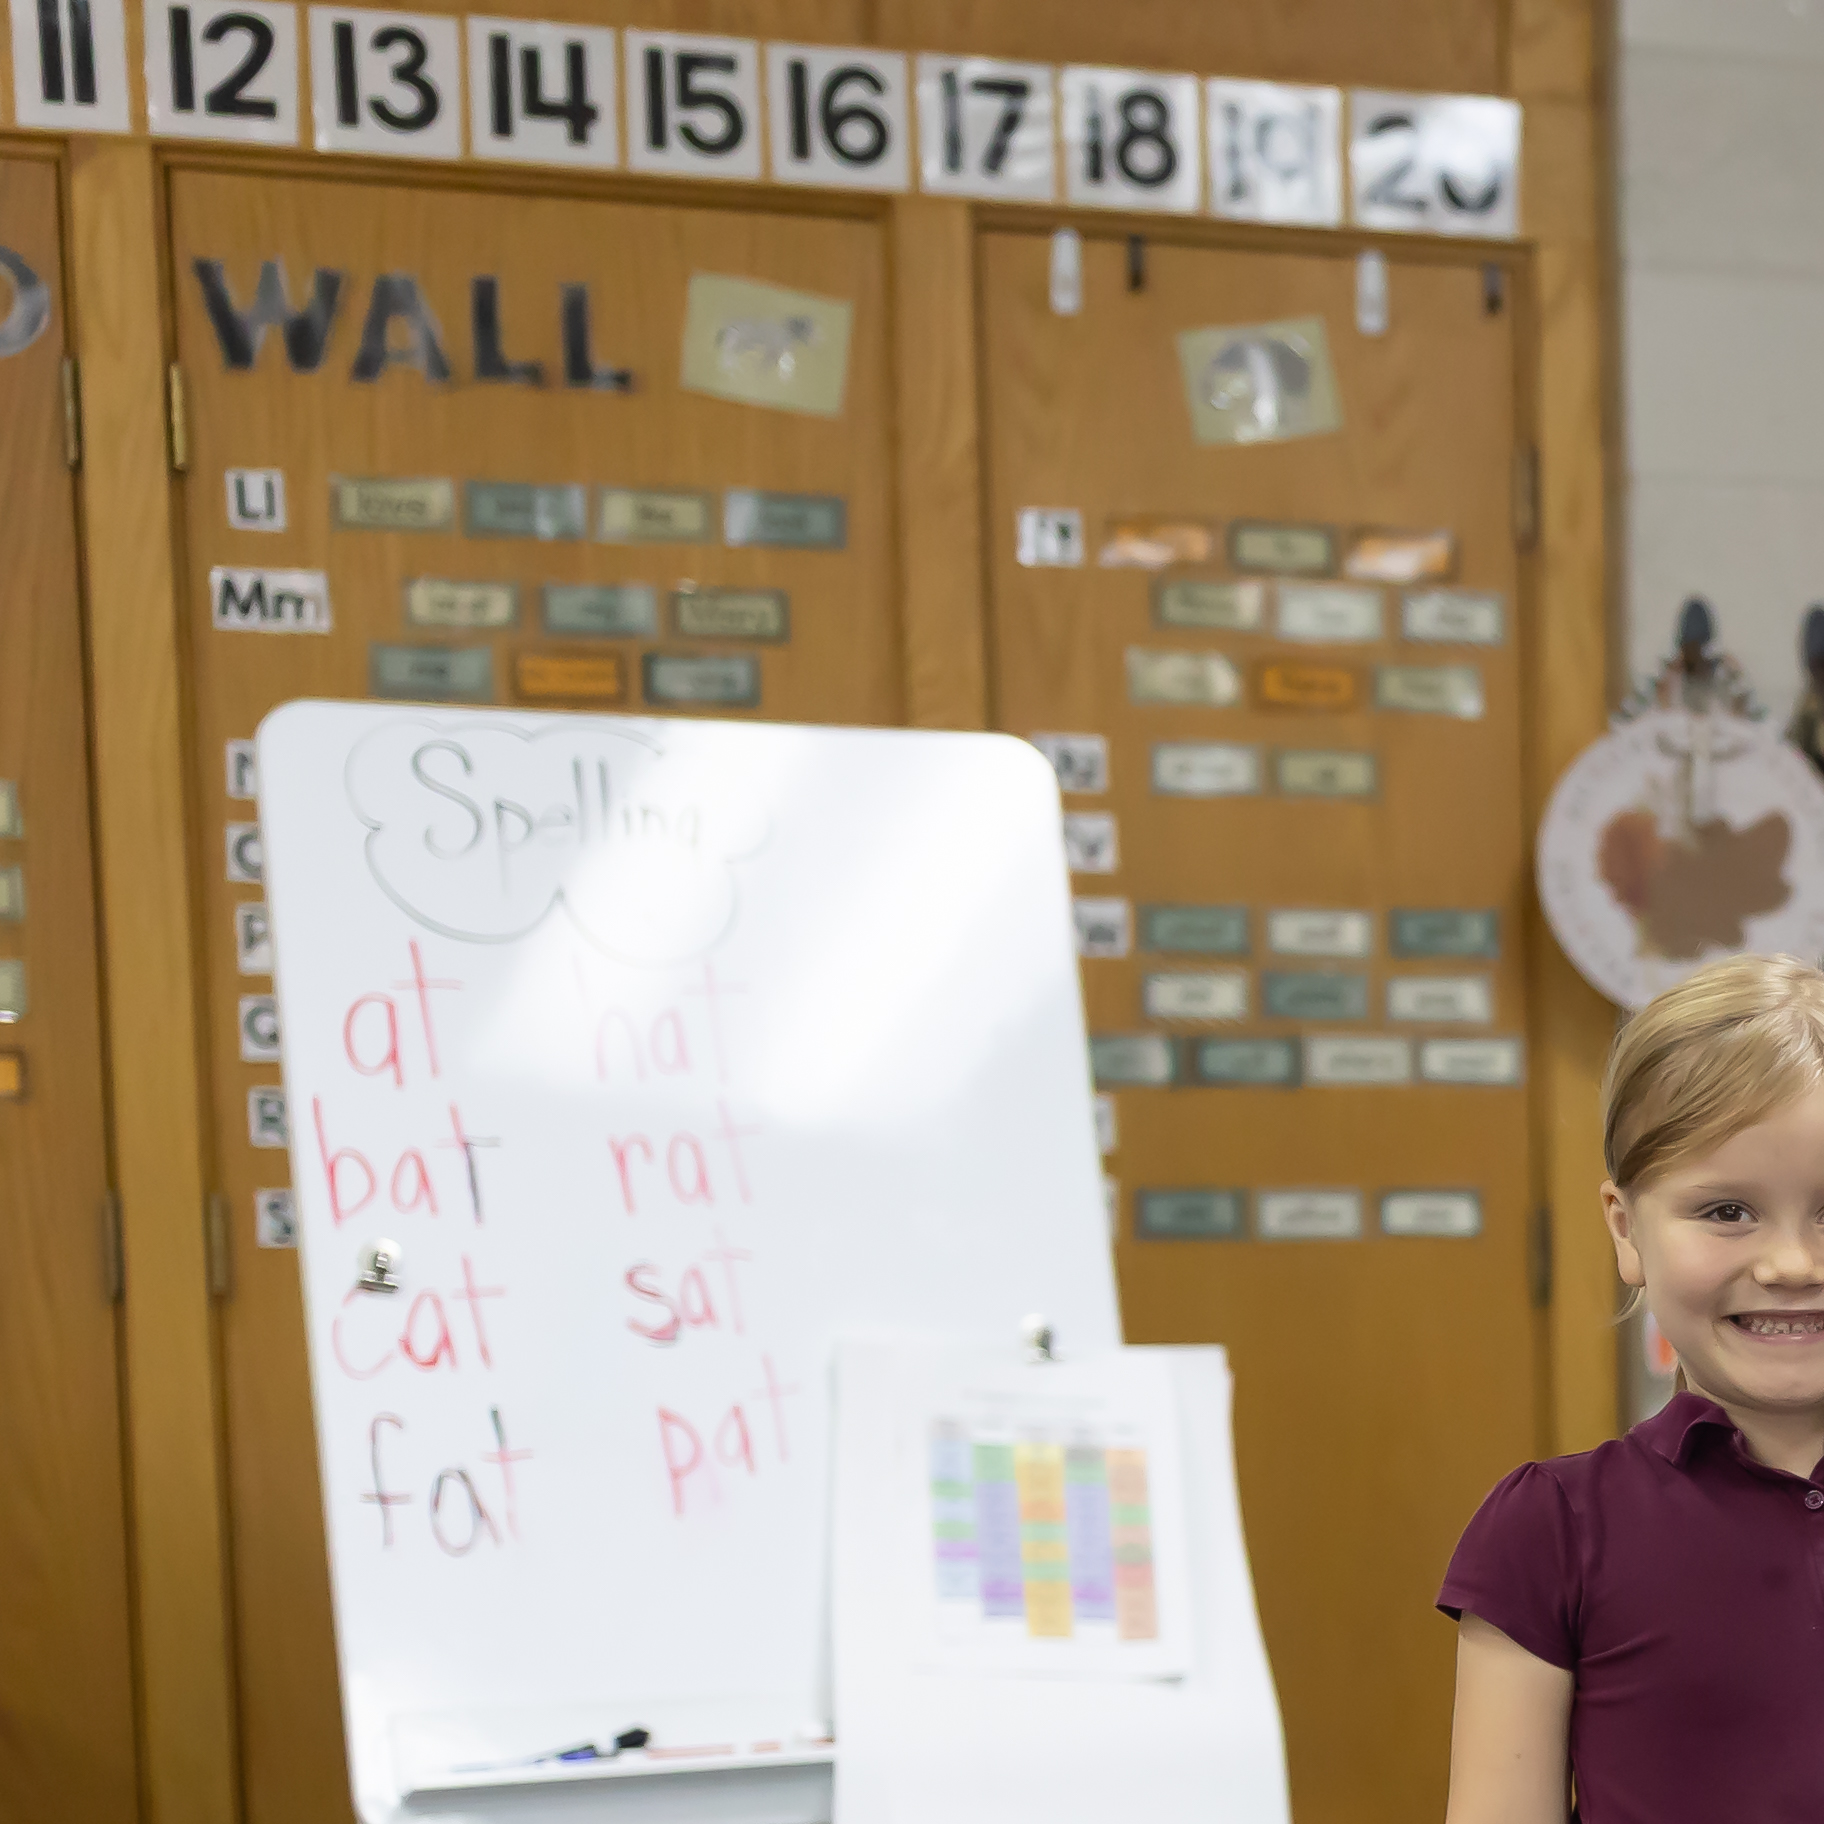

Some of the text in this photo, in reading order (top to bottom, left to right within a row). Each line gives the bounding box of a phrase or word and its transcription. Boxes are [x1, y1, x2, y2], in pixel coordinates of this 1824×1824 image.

[36, 0, 97, 105] 11
[169, 7, 278, 118] 12
[334, 20, 440, 132] 13
[490, 32, 598, 144] 14
[645, 47, 744, 155] 15
[788, 59, 890, 167] 16
[941, 70, 1031, 174] 17
[1083, 84, 1178, 188] 18
[1366, 111, 1503, 214] 20
[193, 254, 637, 392] WALL
[218, 576, 324, 621] Mm
[342, 940, 464, 1088] at
[312, 1096, 502, 1226] bat
[607, 1098, 764, 1216] rat
[331, 1256, 505, 1381] cat
[624, 1230, 754, 1345] sat
[360, 1406, 533, 1557] fat
[654, 1353, 800, 1519] pat
